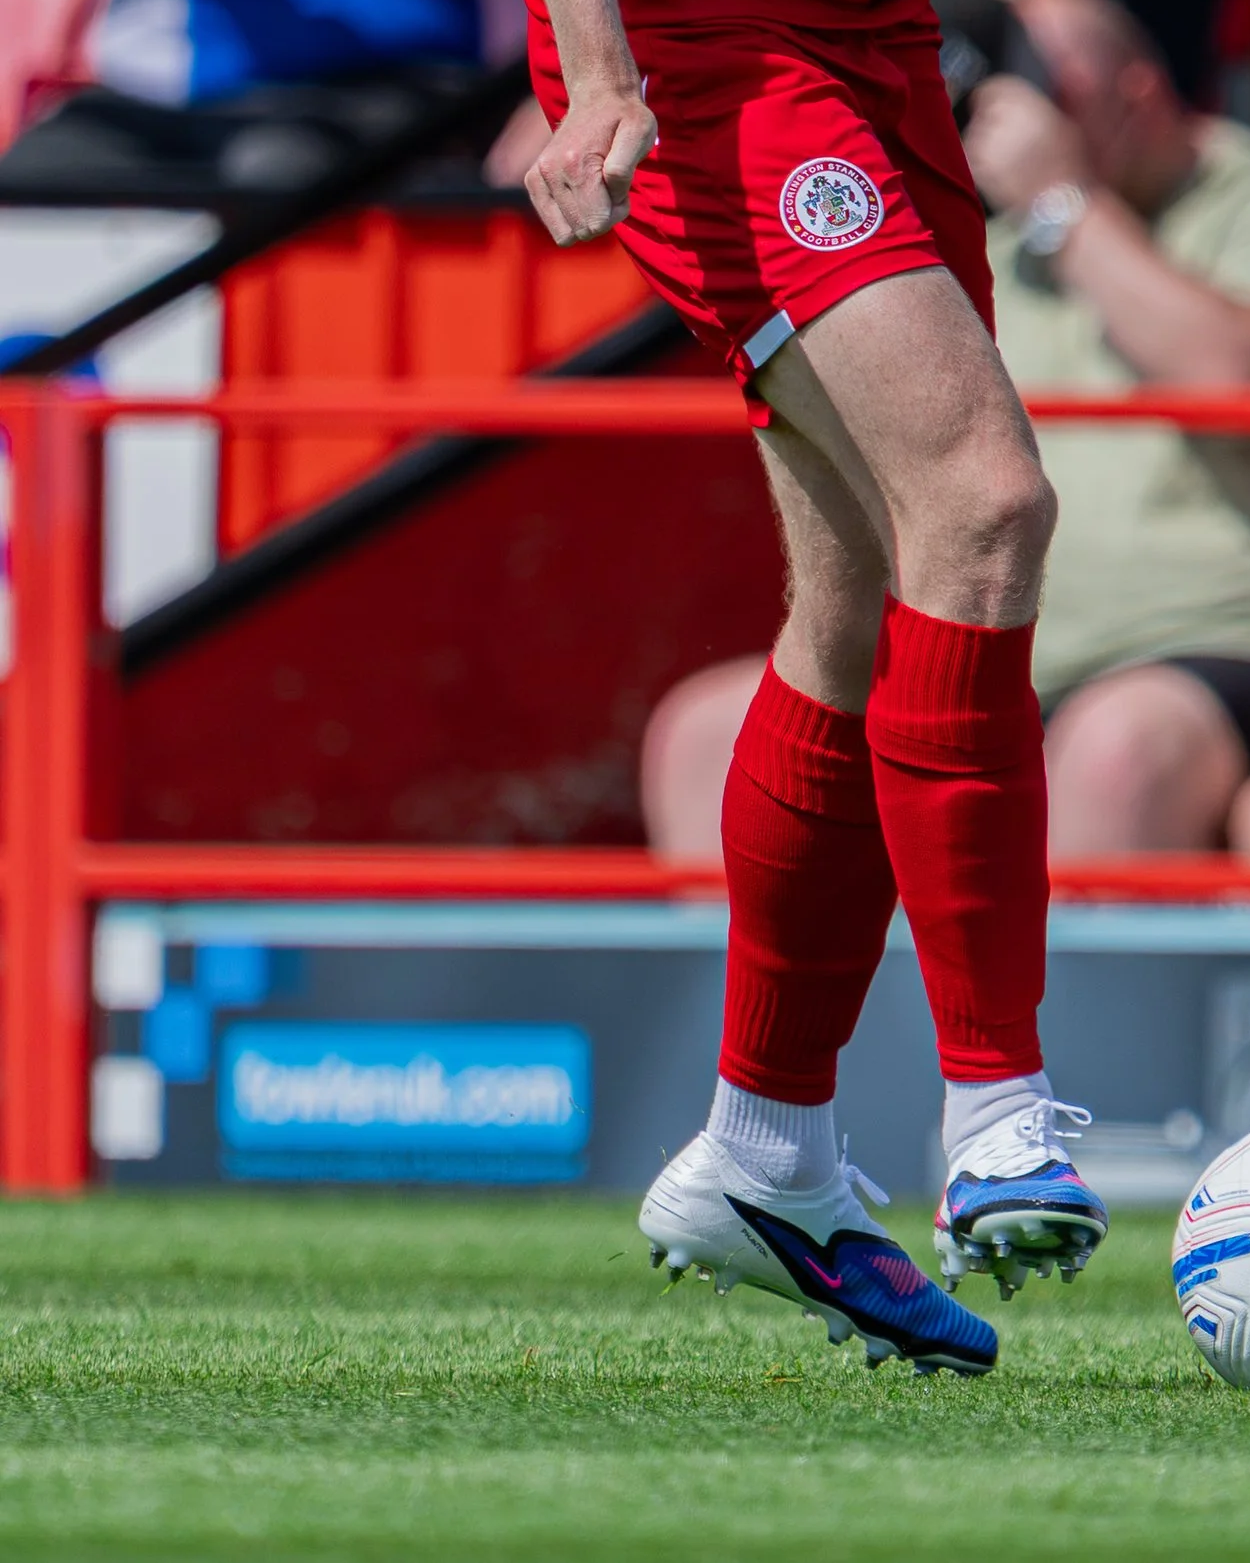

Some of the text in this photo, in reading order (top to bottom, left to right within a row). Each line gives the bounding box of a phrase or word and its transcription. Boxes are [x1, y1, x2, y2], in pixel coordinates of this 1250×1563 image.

[785, 163, 872, 221] ACCRINGTON STANLEY
[800, 204, 878, 246] FOOTBALL CLUB
